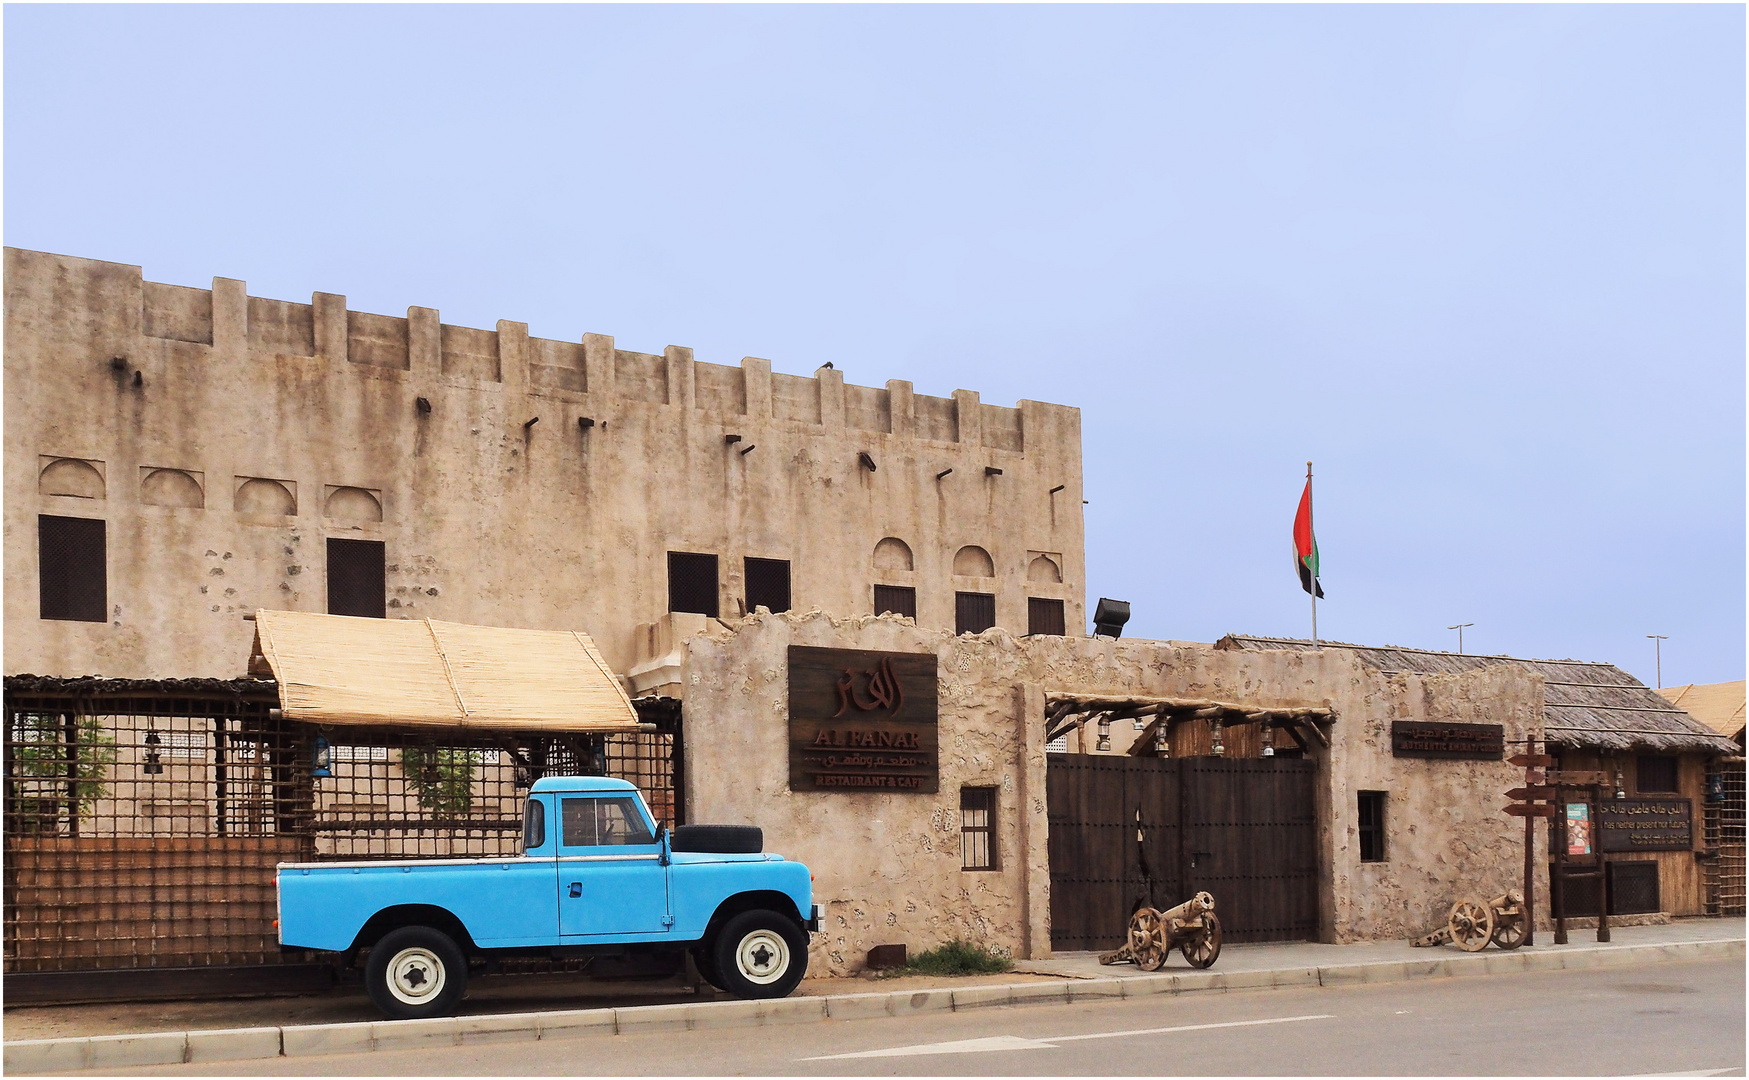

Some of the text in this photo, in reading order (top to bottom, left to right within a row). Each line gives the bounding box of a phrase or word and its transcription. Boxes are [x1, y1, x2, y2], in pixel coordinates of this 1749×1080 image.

[814, 728, 921, 748] AL FANAR
[1399, 741, 1447, 750] AUTHENTIC
[874, 756, 916, 768] مطعم
[815, 775, 886, 787] RESTAURANT
[887, 777, 896, 787] &
[1604, 820, 1614, 829] has
[1636, 820, 1657, 830] present
